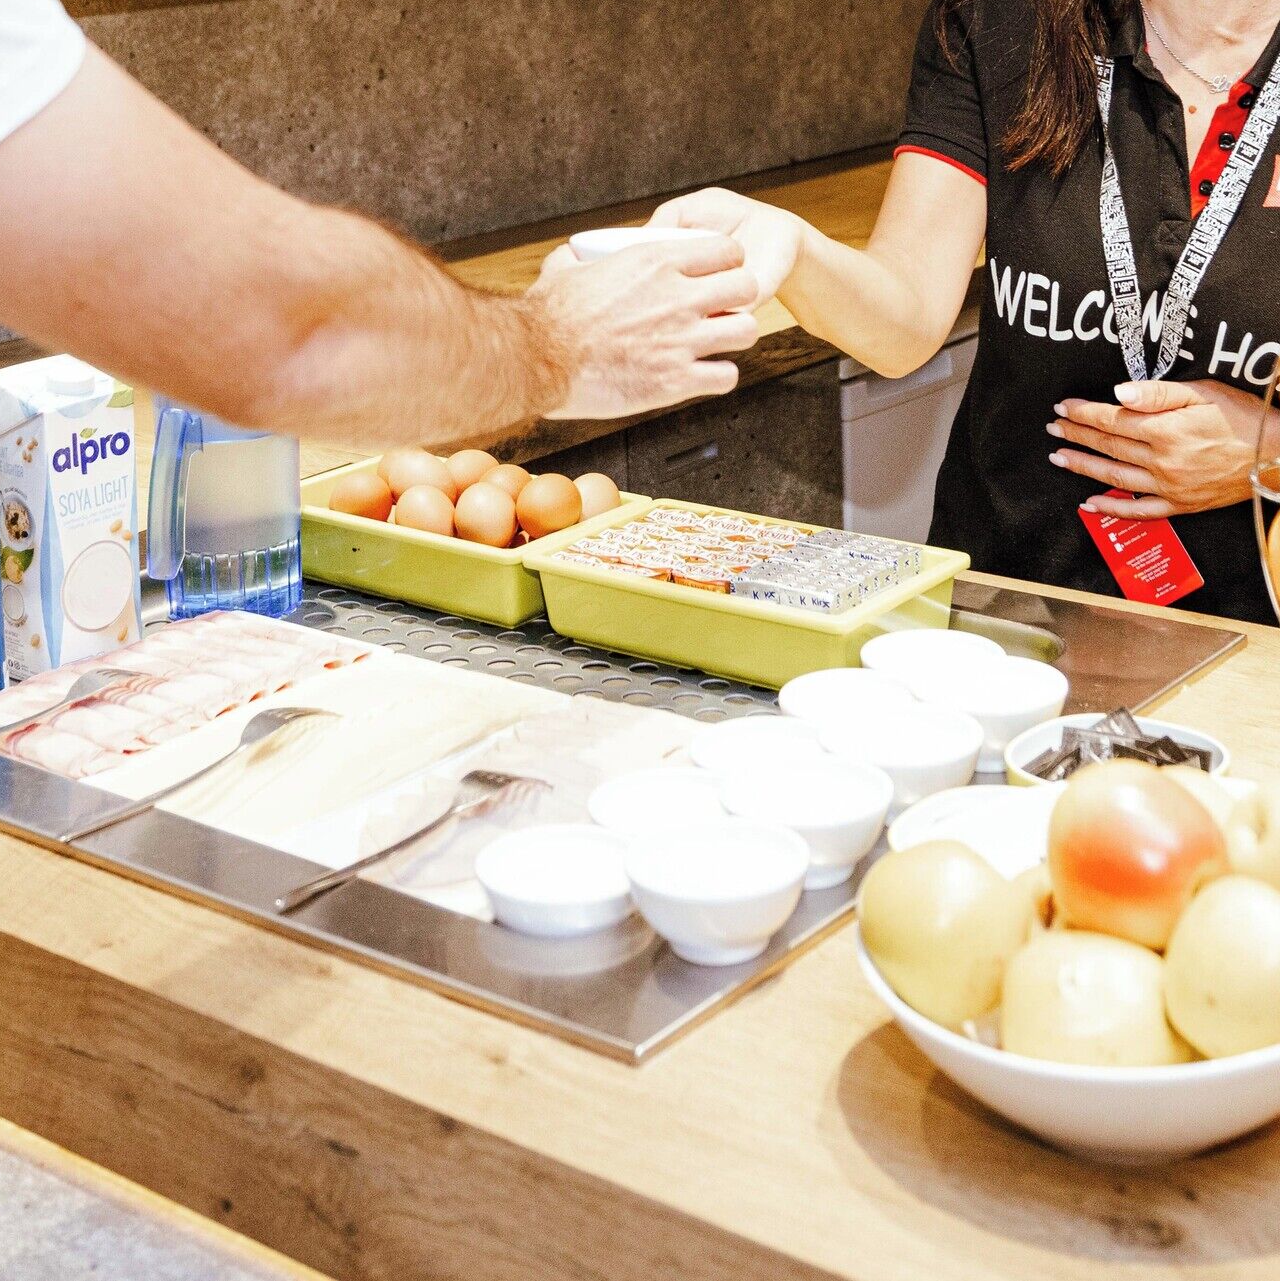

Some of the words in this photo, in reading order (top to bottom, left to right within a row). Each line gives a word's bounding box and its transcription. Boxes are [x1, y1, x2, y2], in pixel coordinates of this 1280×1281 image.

[52, 431, 130, 475] alpro
[58, 487, 92, 517] SOYA
[95, 475, 128, 507] LIGHT
